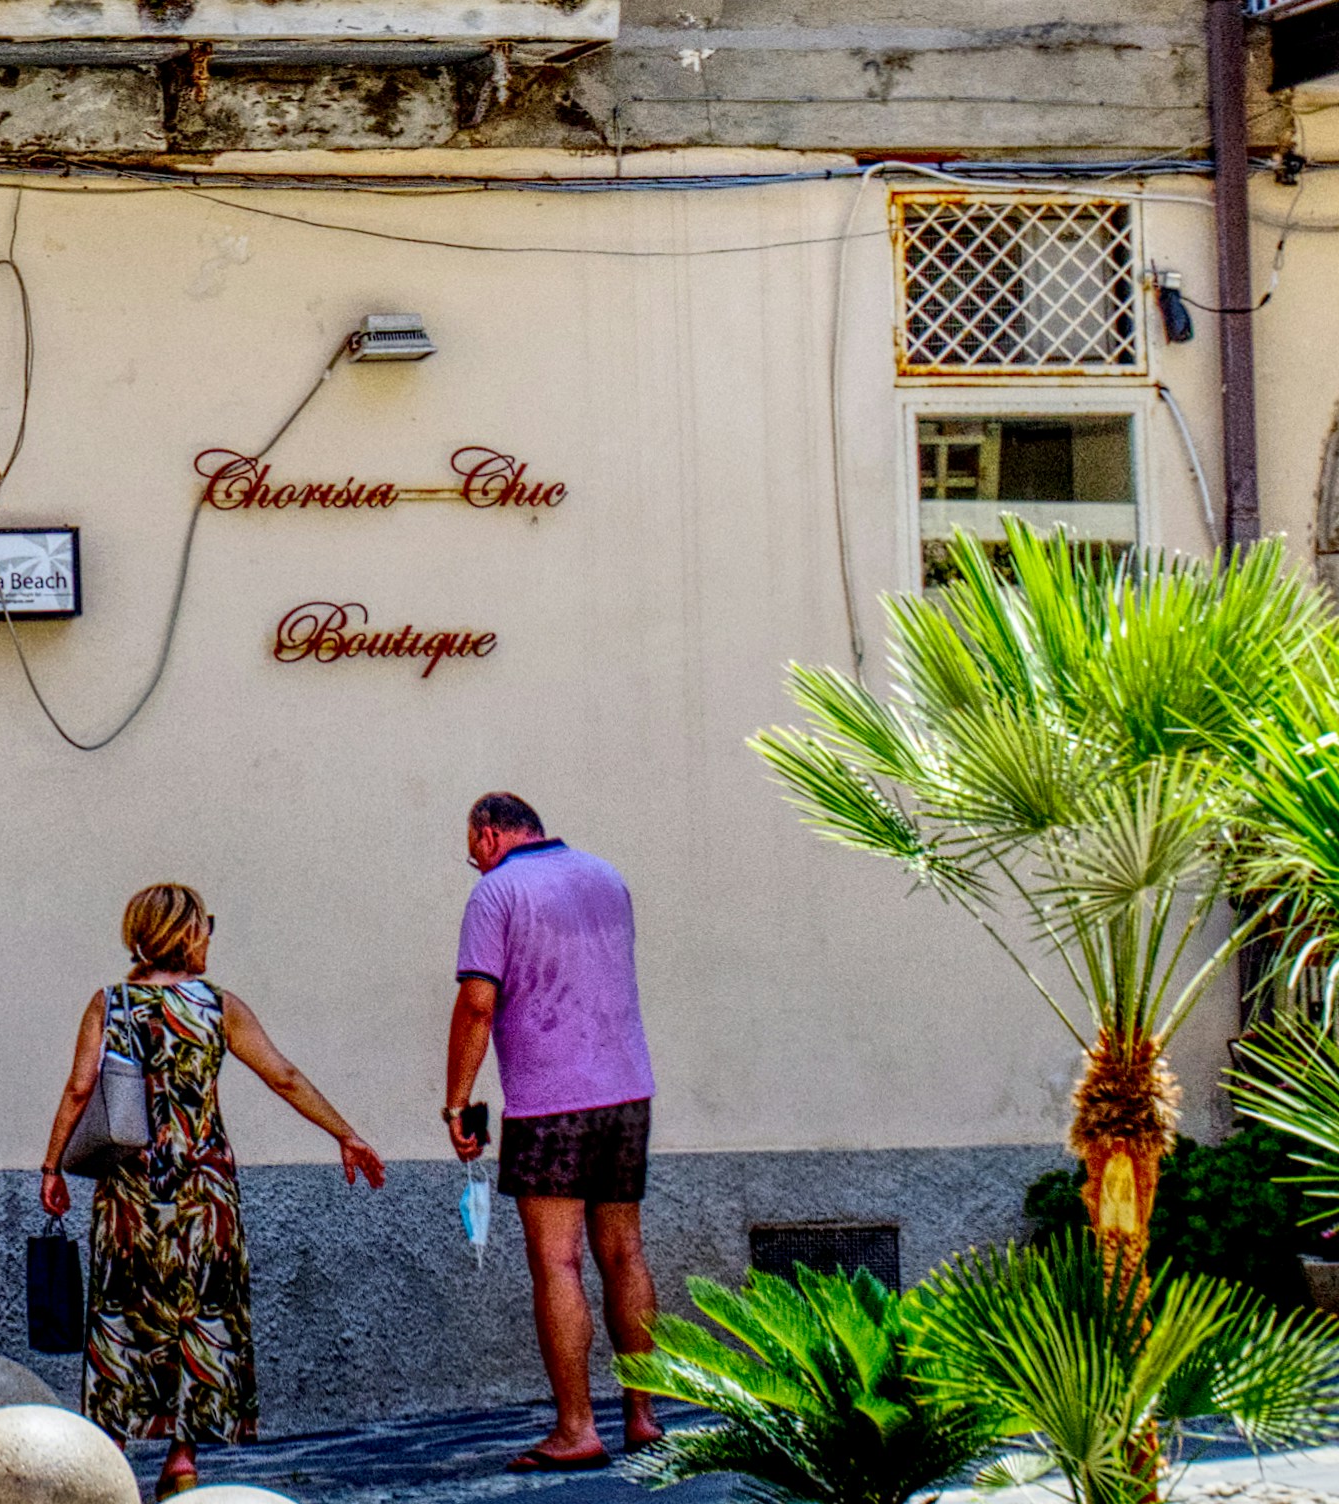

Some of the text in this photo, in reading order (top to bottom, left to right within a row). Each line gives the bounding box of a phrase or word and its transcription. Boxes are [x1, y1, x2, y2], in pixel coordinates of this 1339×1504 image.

[194, 446, 568, 510] Chorisia Chic
[11, 571, 68, 590] Beach
[274, 601, 497, 678] Boutique
